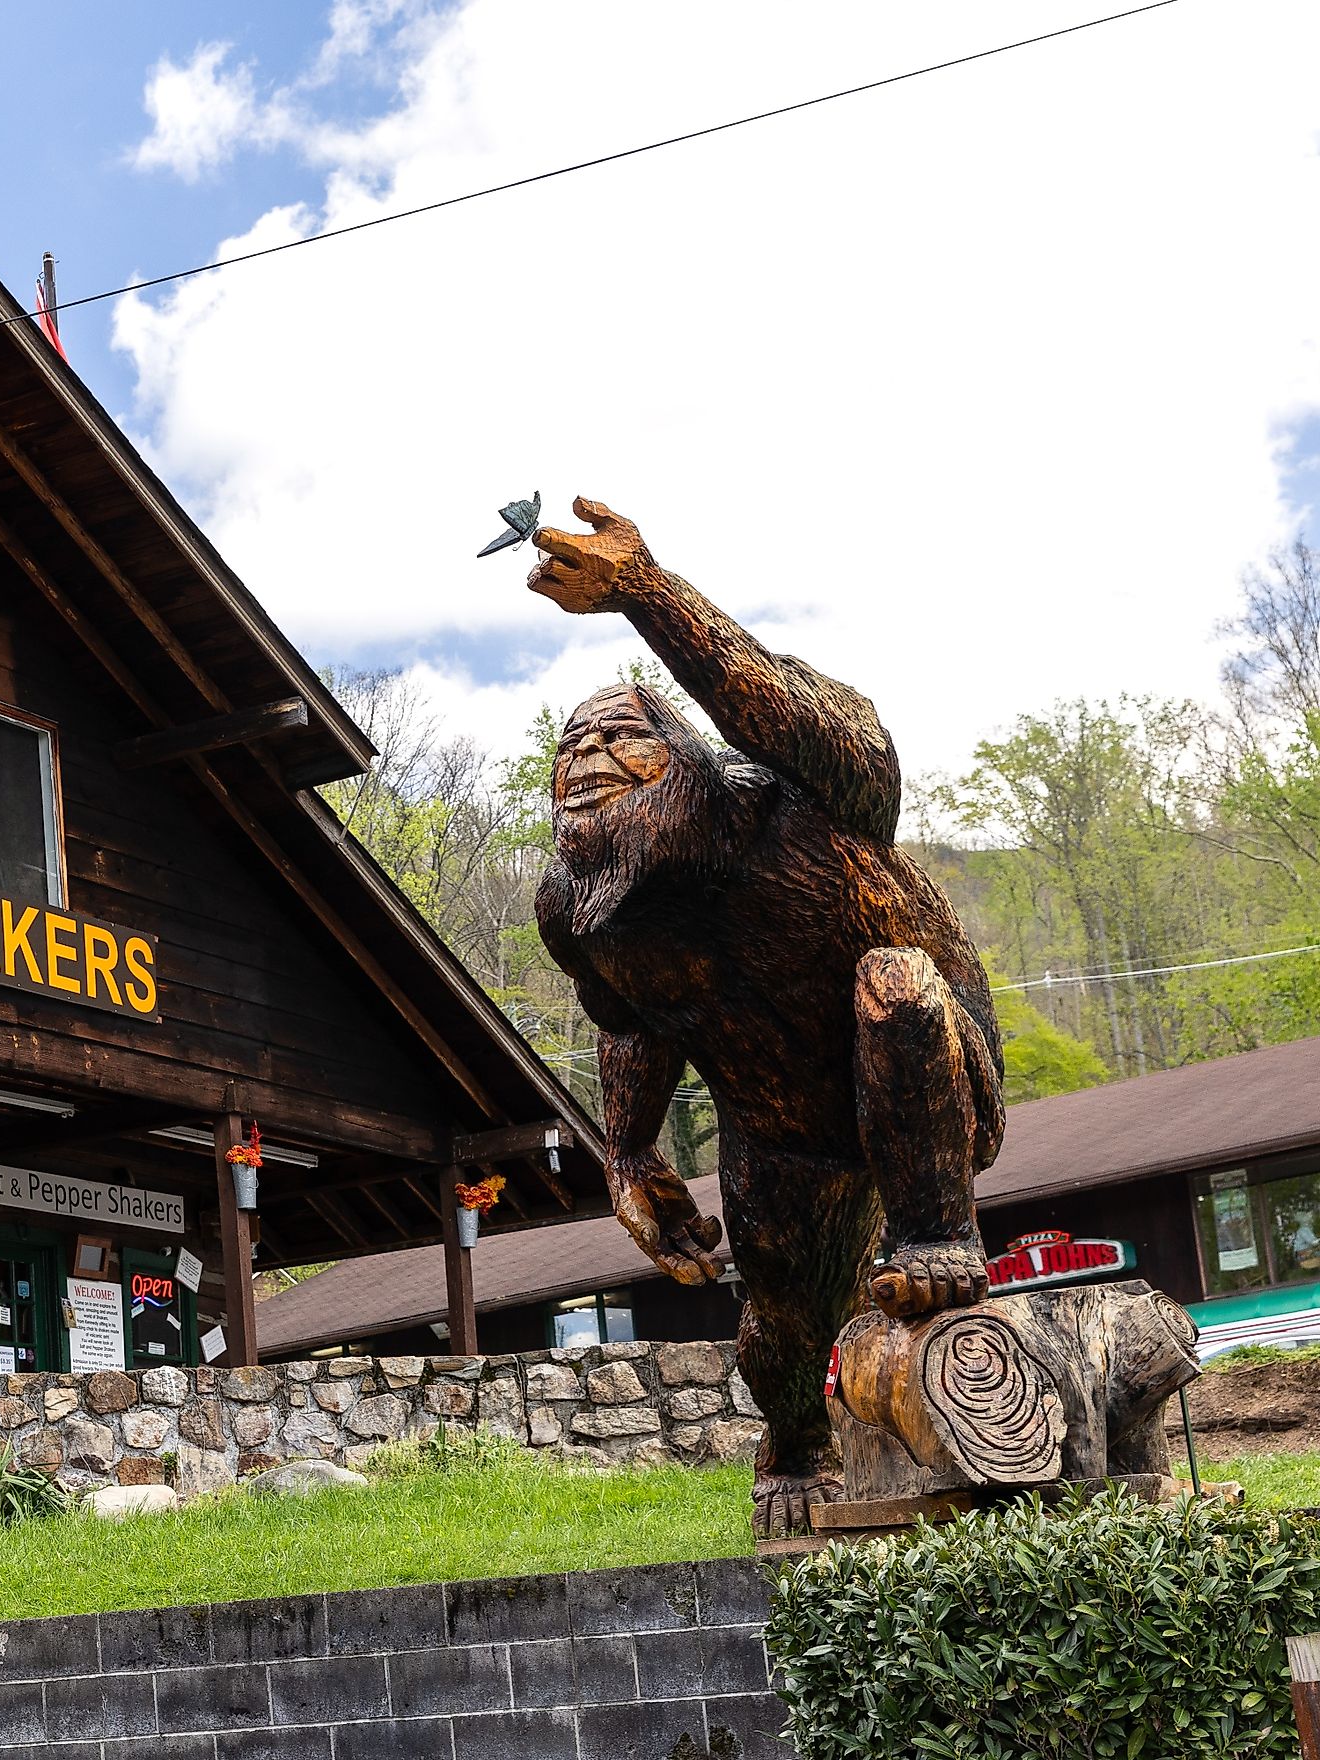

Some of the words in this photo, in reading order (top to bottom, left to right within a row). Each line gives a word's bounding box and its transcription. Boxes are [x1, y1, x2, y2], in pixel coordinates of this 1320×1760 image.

[10, 1177, 23, 1198] &
[28, 1172, 103, 1214] Pepper
[107, 1186, 182, 1225] Shakers
[1020, 1232, 1054, 1245] PIZZA
[986, 1249, 1037, 1286] PA
[1038, 1243, 1119, 1276] JOHNS
[74, 1285, 115, 1301] WELCOME!
